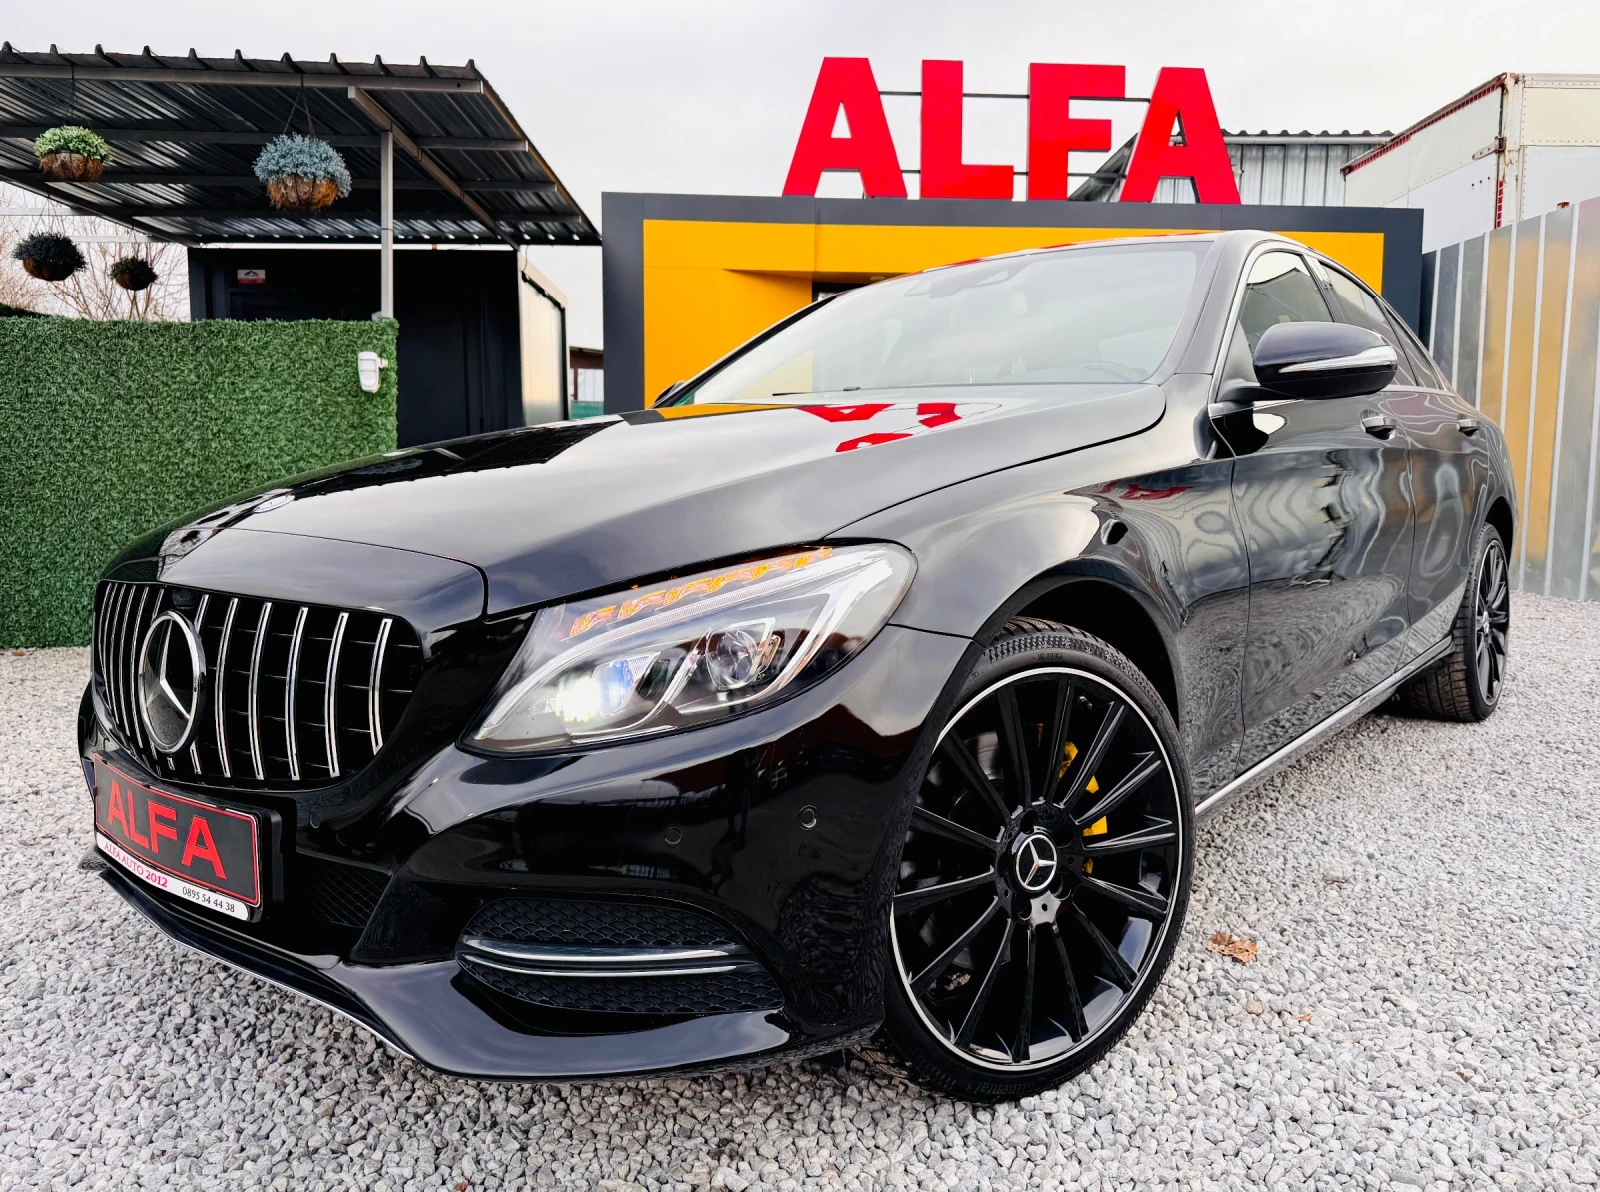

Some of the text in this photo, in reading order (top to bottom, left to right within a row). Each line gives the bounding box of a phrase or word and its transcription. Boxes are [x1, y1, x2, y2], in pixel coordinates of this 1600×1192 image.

[782, 56, 1242, 205] ALFA
[104, 841, 168, 888] ALFA AUTO 2012
[107, 780, 227, 880] ALFA
[182, 886, 235, 913] 0895 54 44 38
